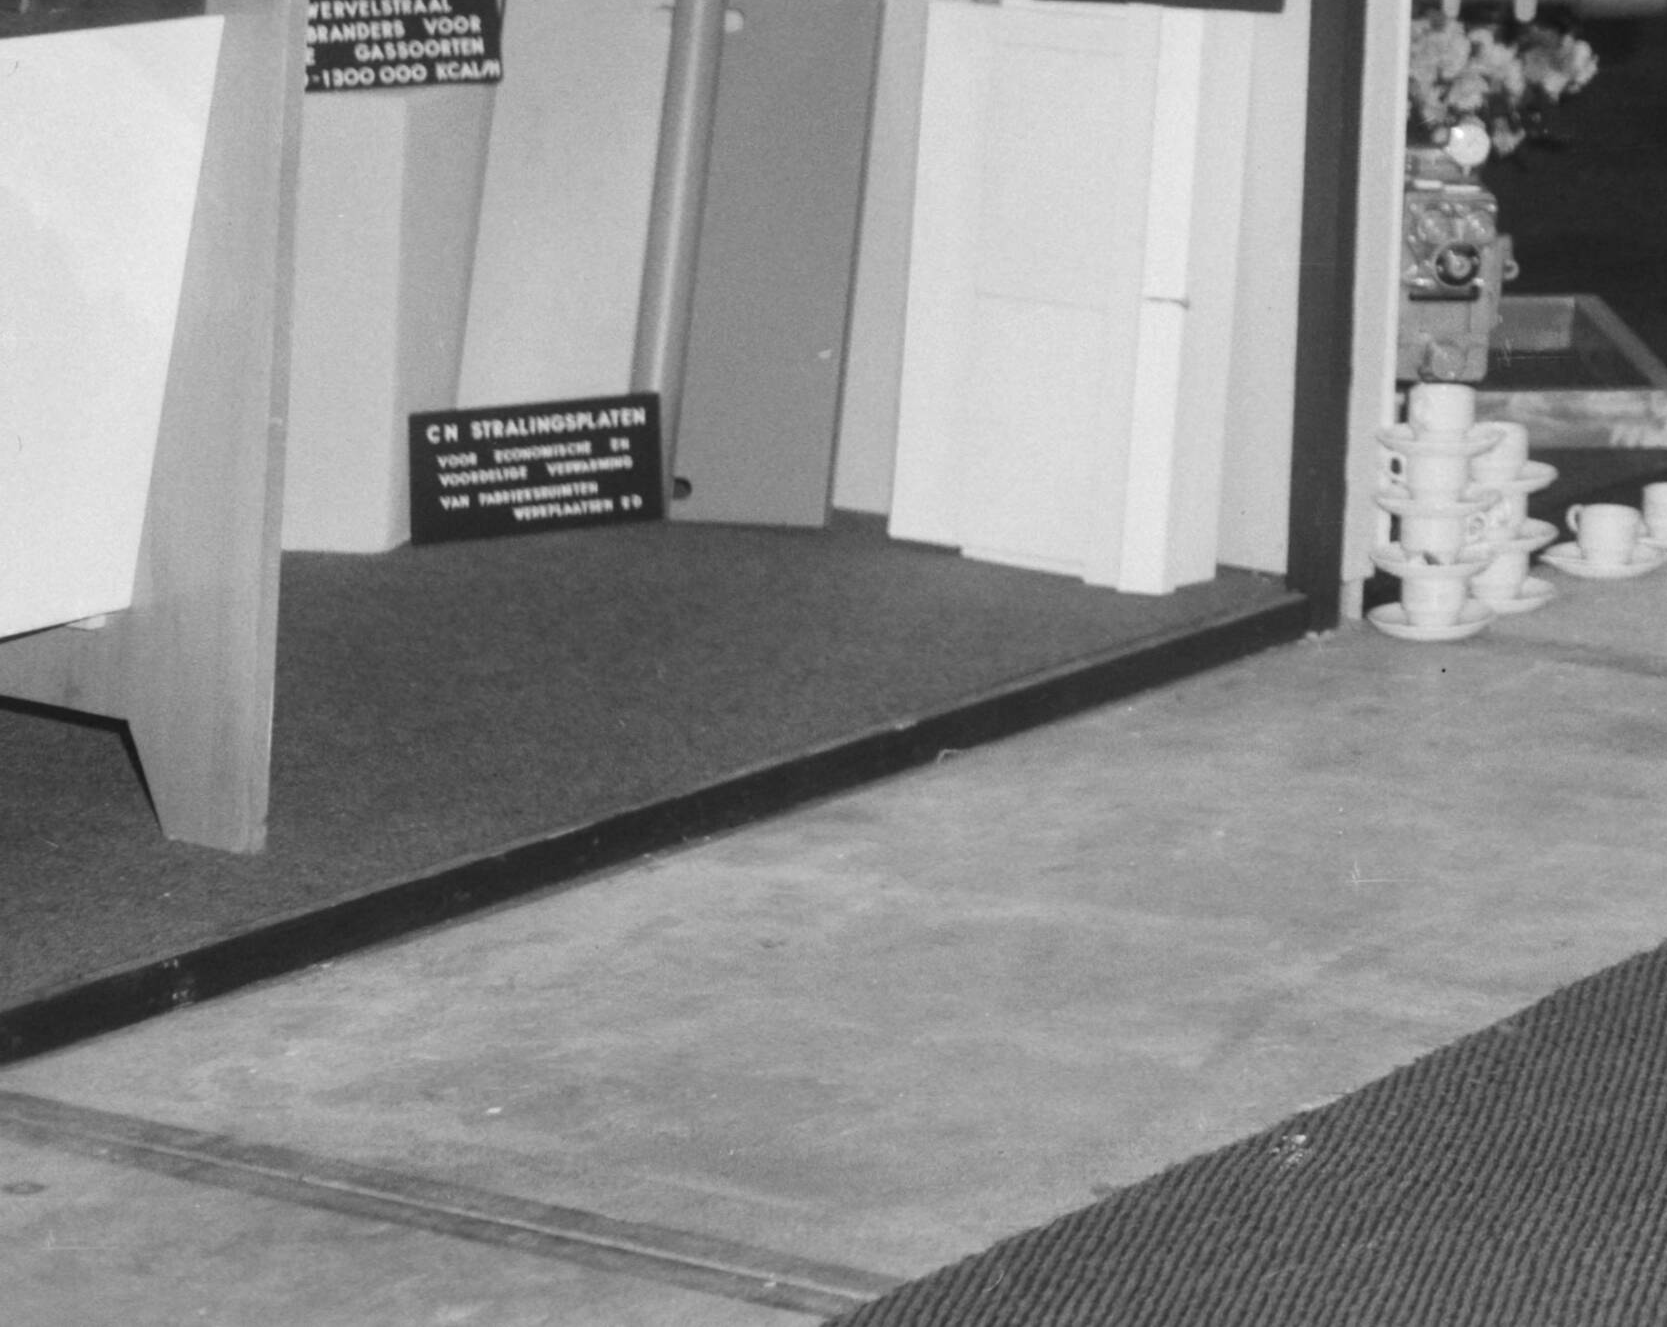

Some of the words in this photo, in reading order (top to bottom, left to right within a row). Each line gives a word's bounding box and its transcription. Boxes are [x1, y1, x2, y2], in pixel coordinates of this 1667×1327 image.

[423, 14, 481, 35] VOOR
[354, 36, 485, 62] GASSOORTEN
[470, 406, 646, 441] STRALINGSPLATEN
[436, 451, 477, 469] VOOR
[493, 440, 592, 464] ECONOMISCHE
[609, 437, 630, 452] EN
[437, 465, 528, 488] VOORDELIGE
[546, 454, 633, 477] VERWARMING
[439, 494, 470, 511] VAN
